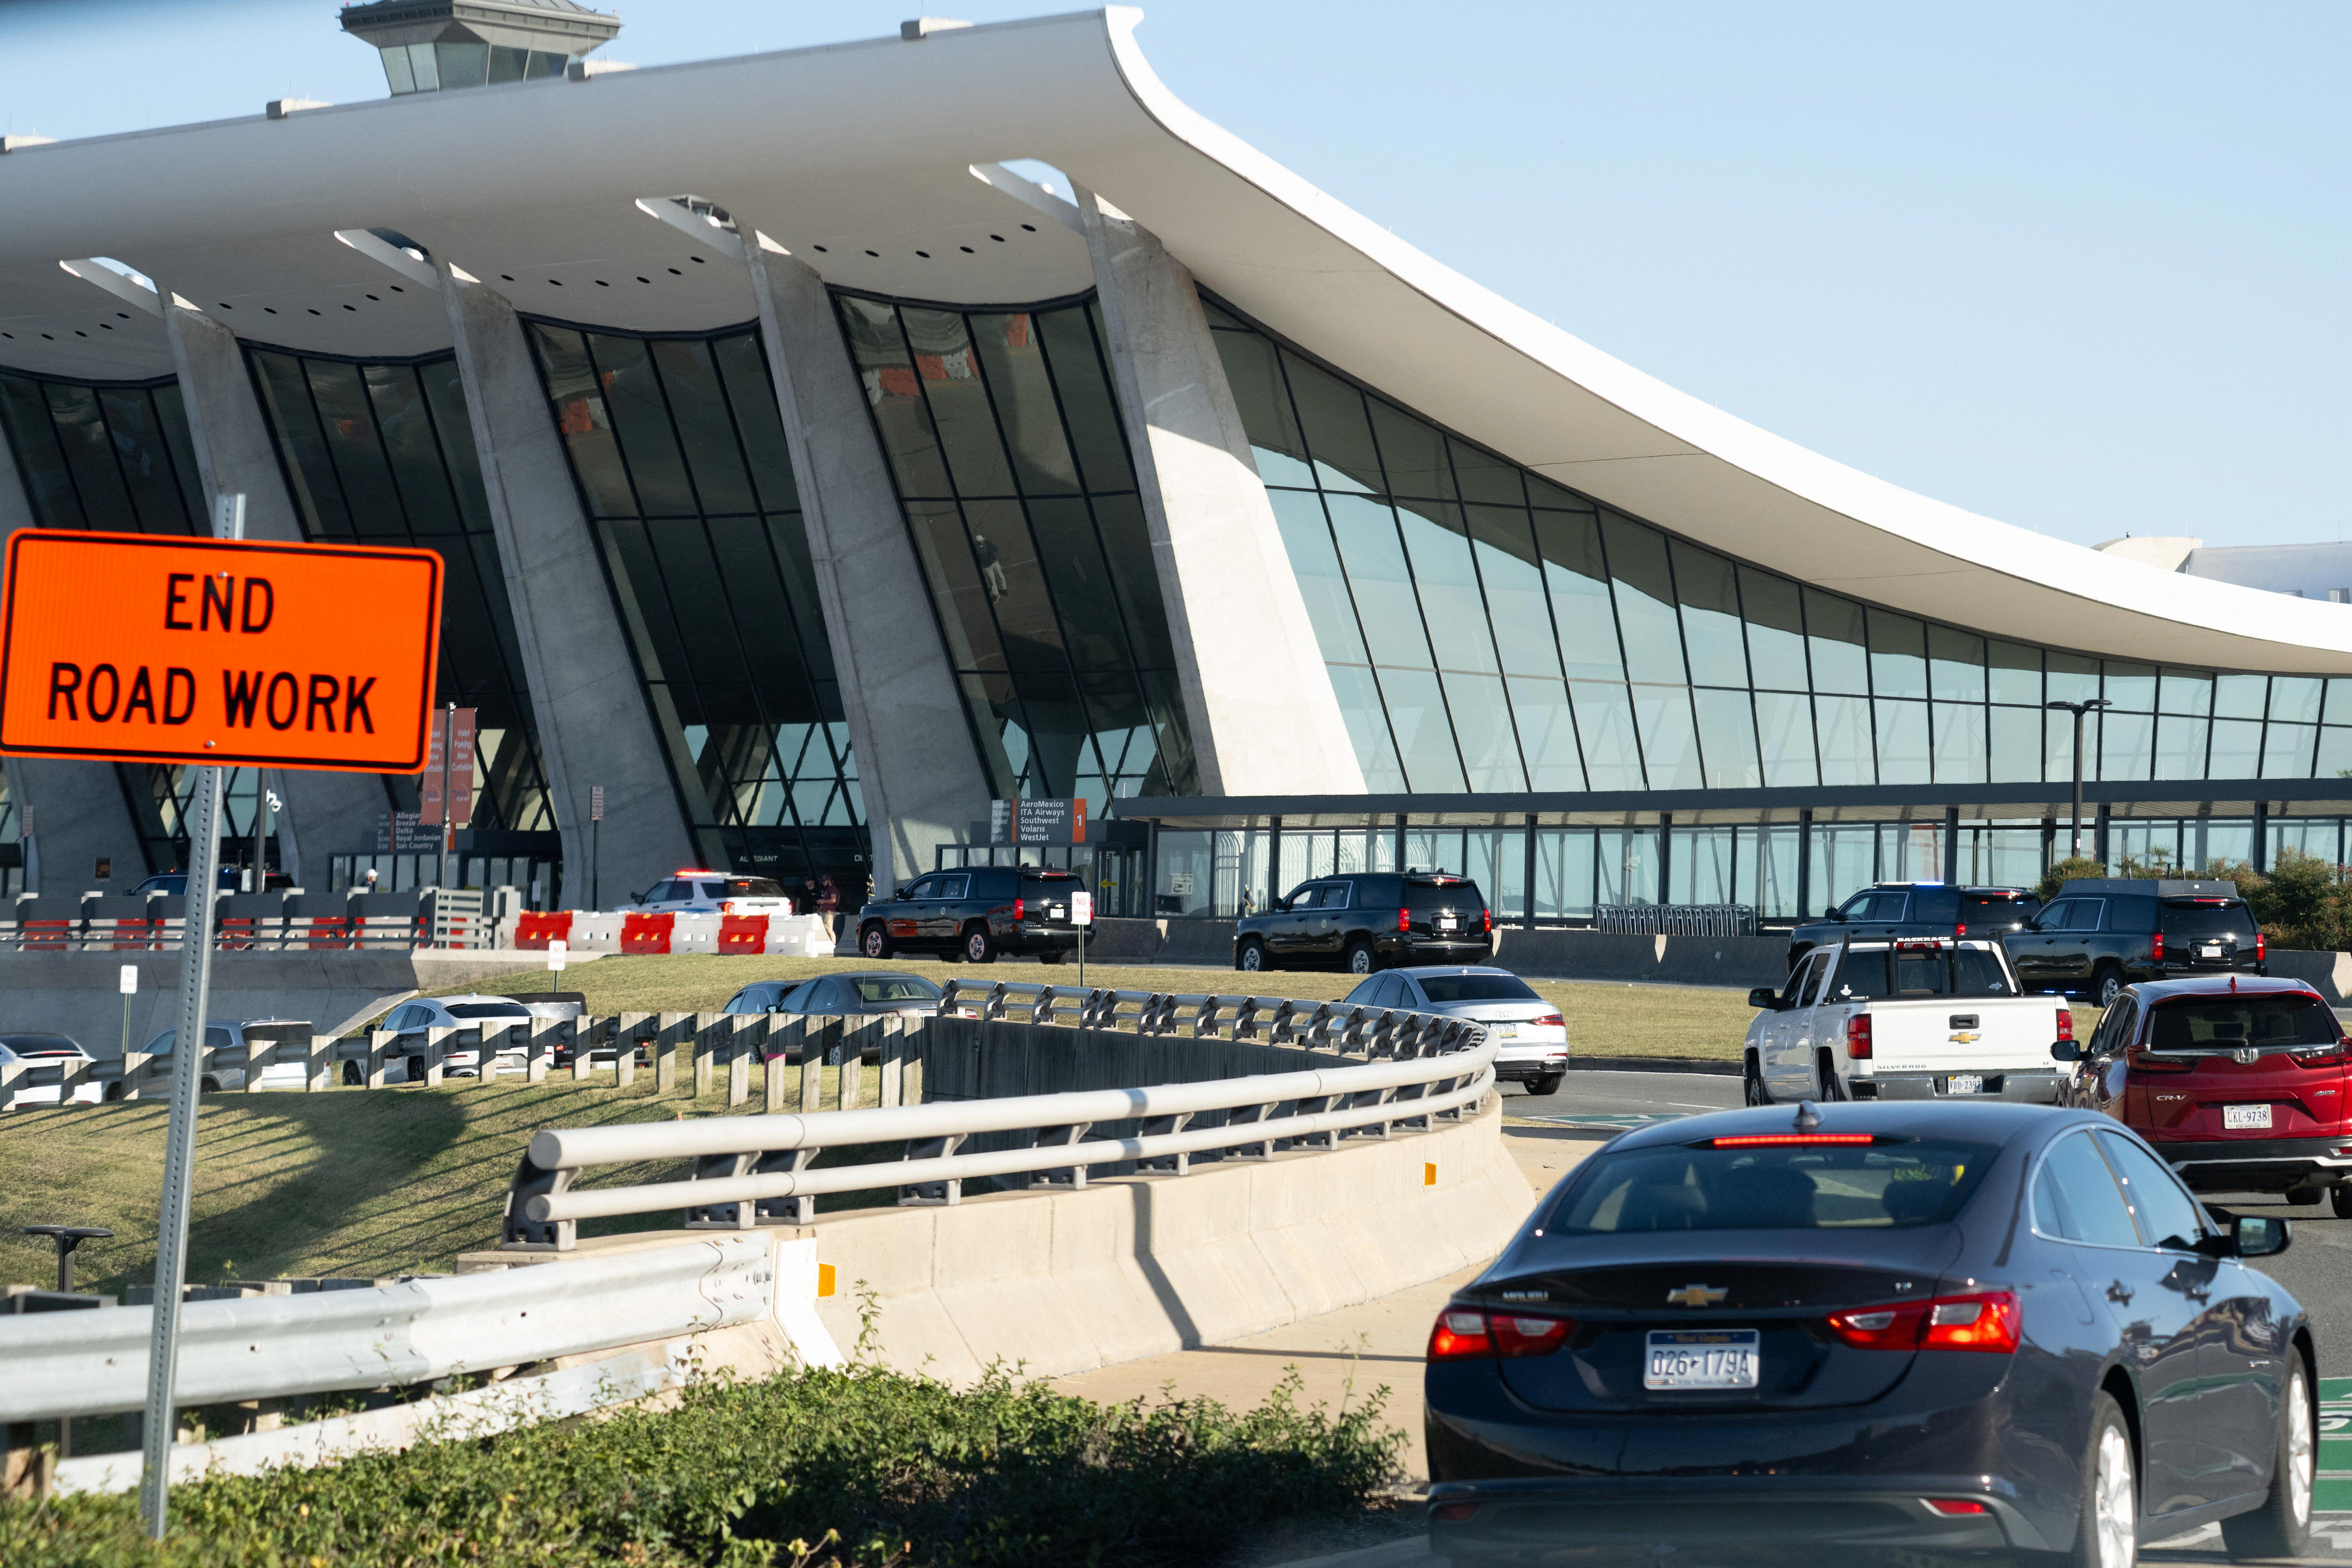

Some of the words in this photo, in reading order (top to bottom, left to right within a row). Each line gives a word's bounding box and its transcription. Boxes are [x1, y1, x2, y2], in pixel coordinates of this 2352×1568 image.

[164, 573, 275, 634] END
[48, 662, 196, 725] ROAD
[223, 669, 377, 734] WORK
[454, 740, 472, 750] Parking
[452, 763, 473, 771] Curbside
[1035, 809, 1065, 817] Airways
[1076, 814, 1082, 826] 1
[1950, 1080, 1981, 1090] VRD-2397
[2227, 1111, 2268, 1123] UKL-9738
